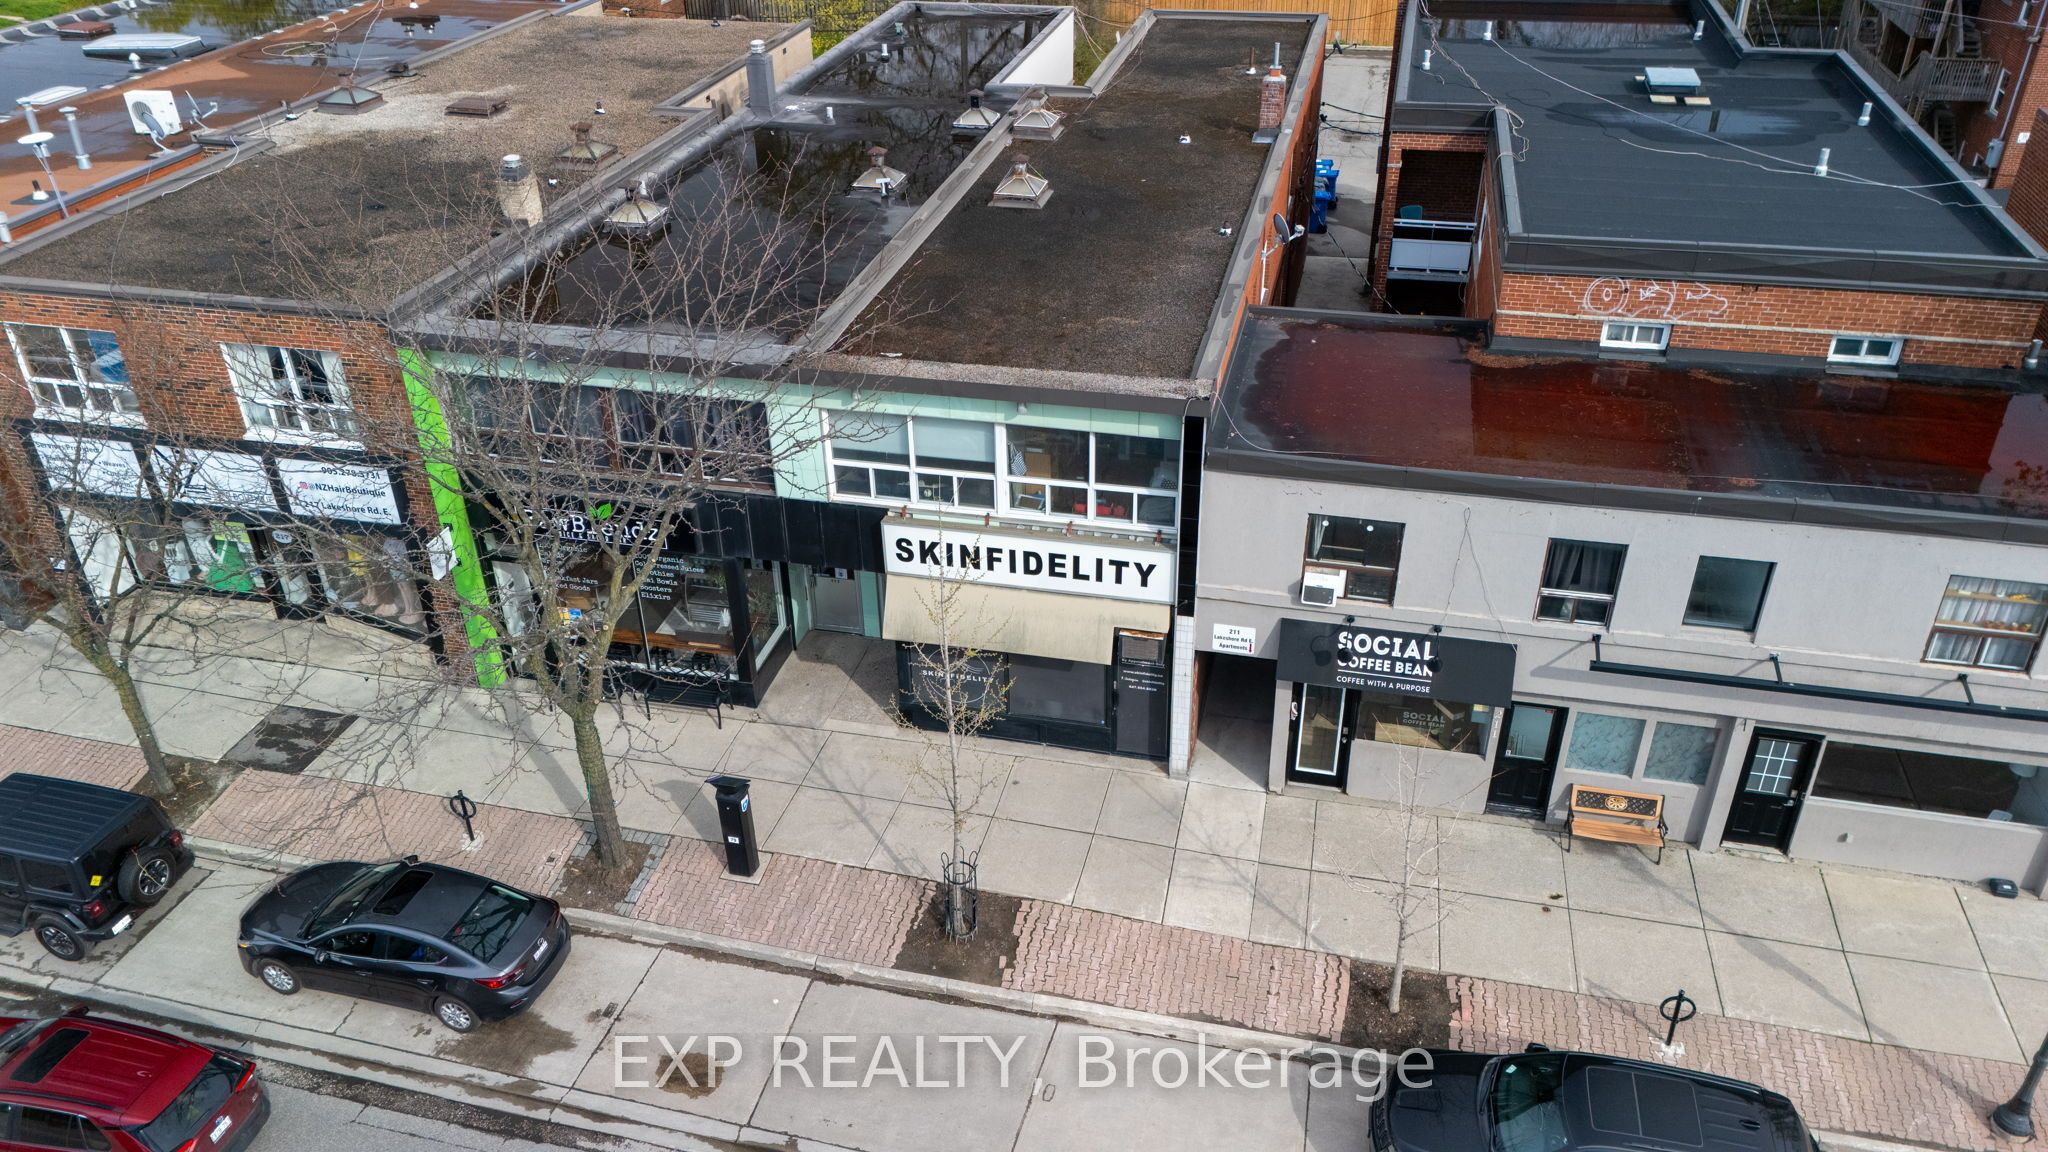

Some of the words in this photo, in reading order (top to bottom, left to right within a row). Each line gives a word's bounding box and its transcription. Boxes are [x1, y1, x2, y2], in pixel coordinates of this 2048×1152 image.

[321, 502, 366, 513] Lakeshore
[656, 556, 685, 564] rganic
[895, 537, 1157, 588] SKINFIDELITY
[655, 563, 680, 571] ressed
[1337, 631, 1435, 661] SOCIAL
[1336, 675, 1365, 686] COFFEE
[1367, 679, 1387, 688] WITH
[1395, 682, 1431, 693] PURPOSE
[1402, 718, 1426, 727] COFFEE
[1403, 711, 1446, 724] SOCIAL
